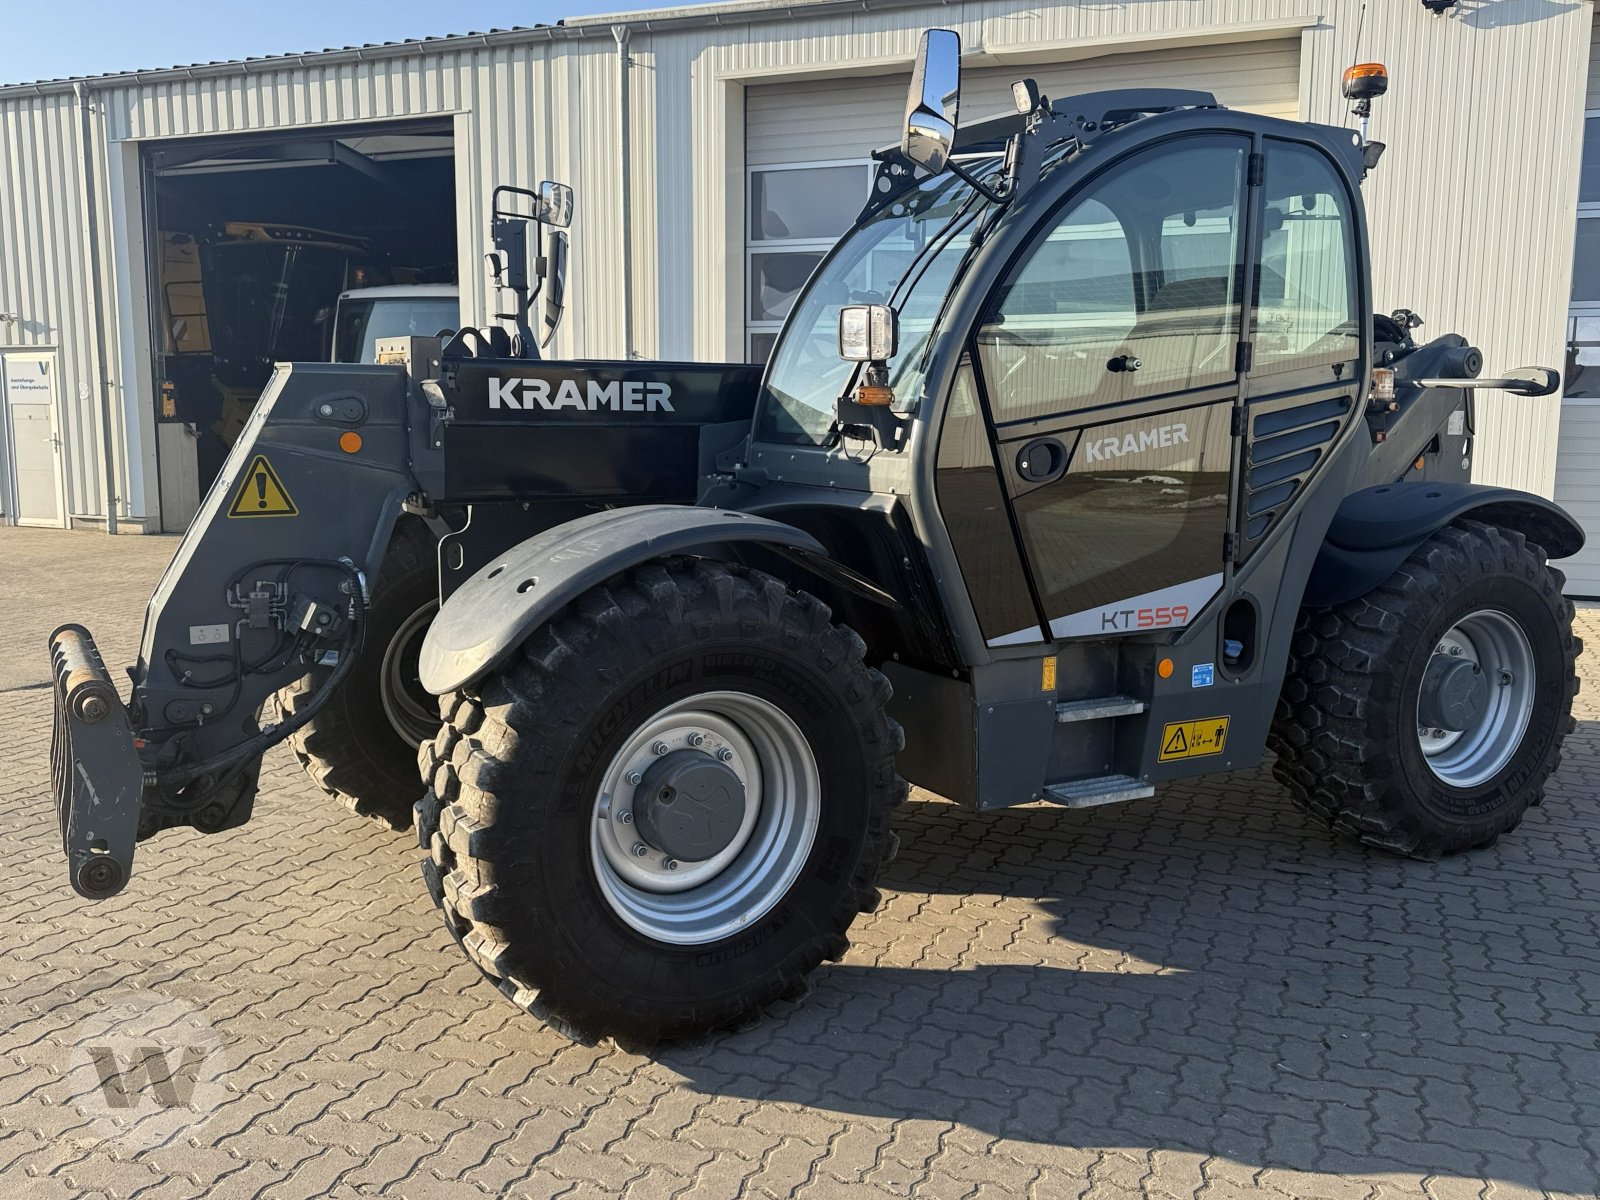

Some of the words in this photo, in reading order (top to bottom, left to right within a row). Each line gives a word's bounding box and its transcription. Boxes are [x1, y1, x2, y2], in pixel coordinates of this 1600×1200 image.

[488, 377, 675, 412] KRAMER
[1085, 423, 1189, 463] KRAMER
[1101, 605, 1188, 630] KT559
[575, 660, 692, 773] MICHELIN
[1508, 711, 1554, 794] MICHELIN
